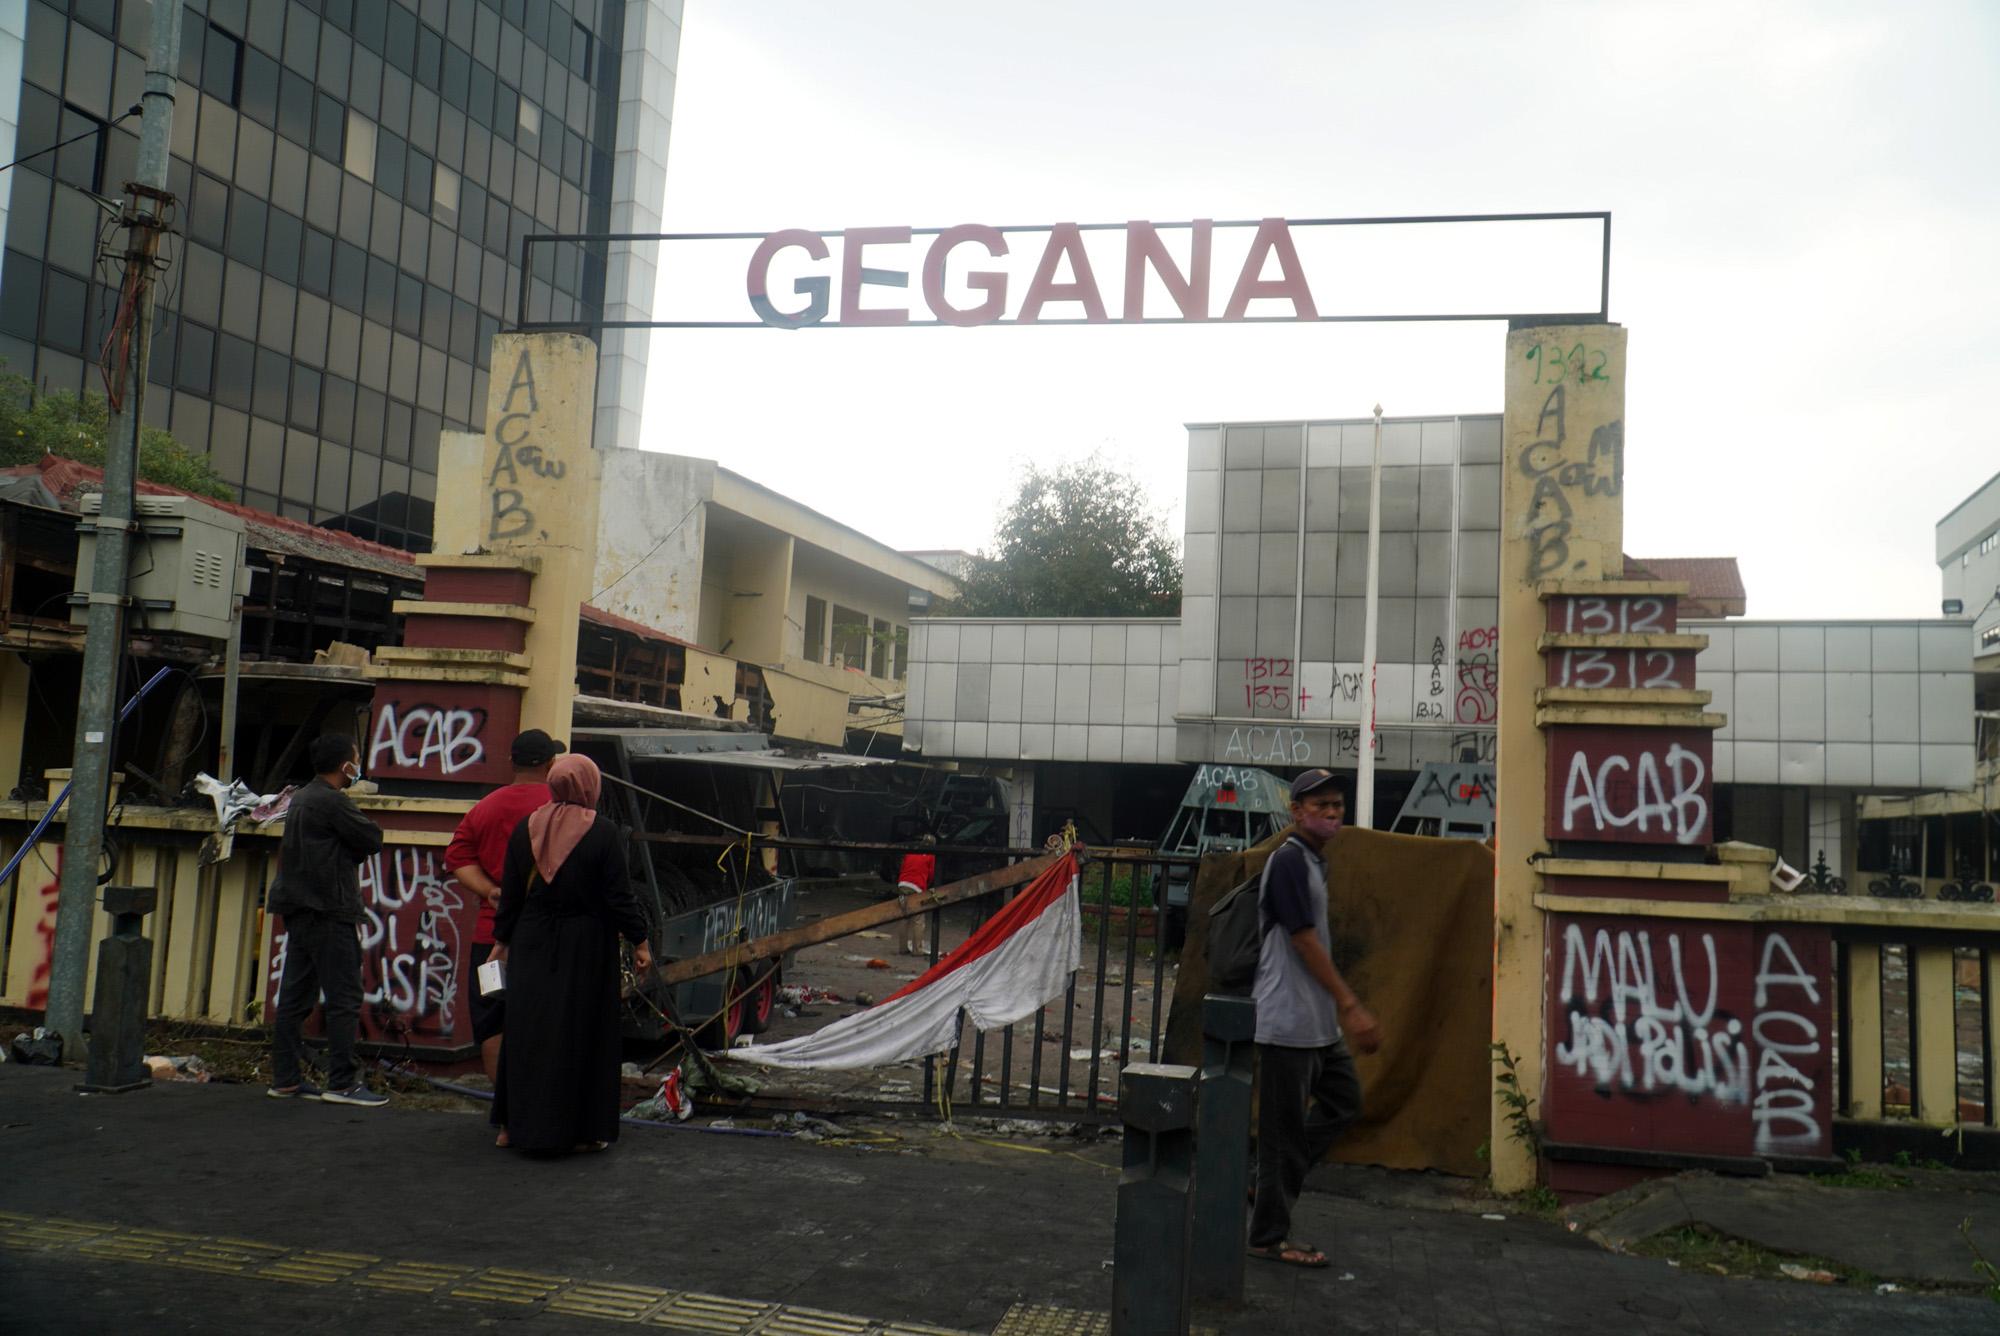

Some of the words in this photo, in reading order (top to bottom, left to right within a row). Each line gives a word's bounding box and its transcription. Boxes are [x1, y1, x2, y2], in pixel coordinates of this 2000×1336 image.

[746, 217, 1319, 329] GEGANA
[1565, 597, 1665, 634] 1312
[1245, 657, 1293, 679] 1312
[1330, 667, 1363, 702] ACA
[1561, 650, 1681, 688] 1312
[368, 703, 483, 774] ACAB
[1412, 771, 1497, 808] ACA
[1563, 742, 1708, 844] ACAB
[1560, 923, 1718, 1028] MALU
[1753, 933, 1821, 1155] ACAB
